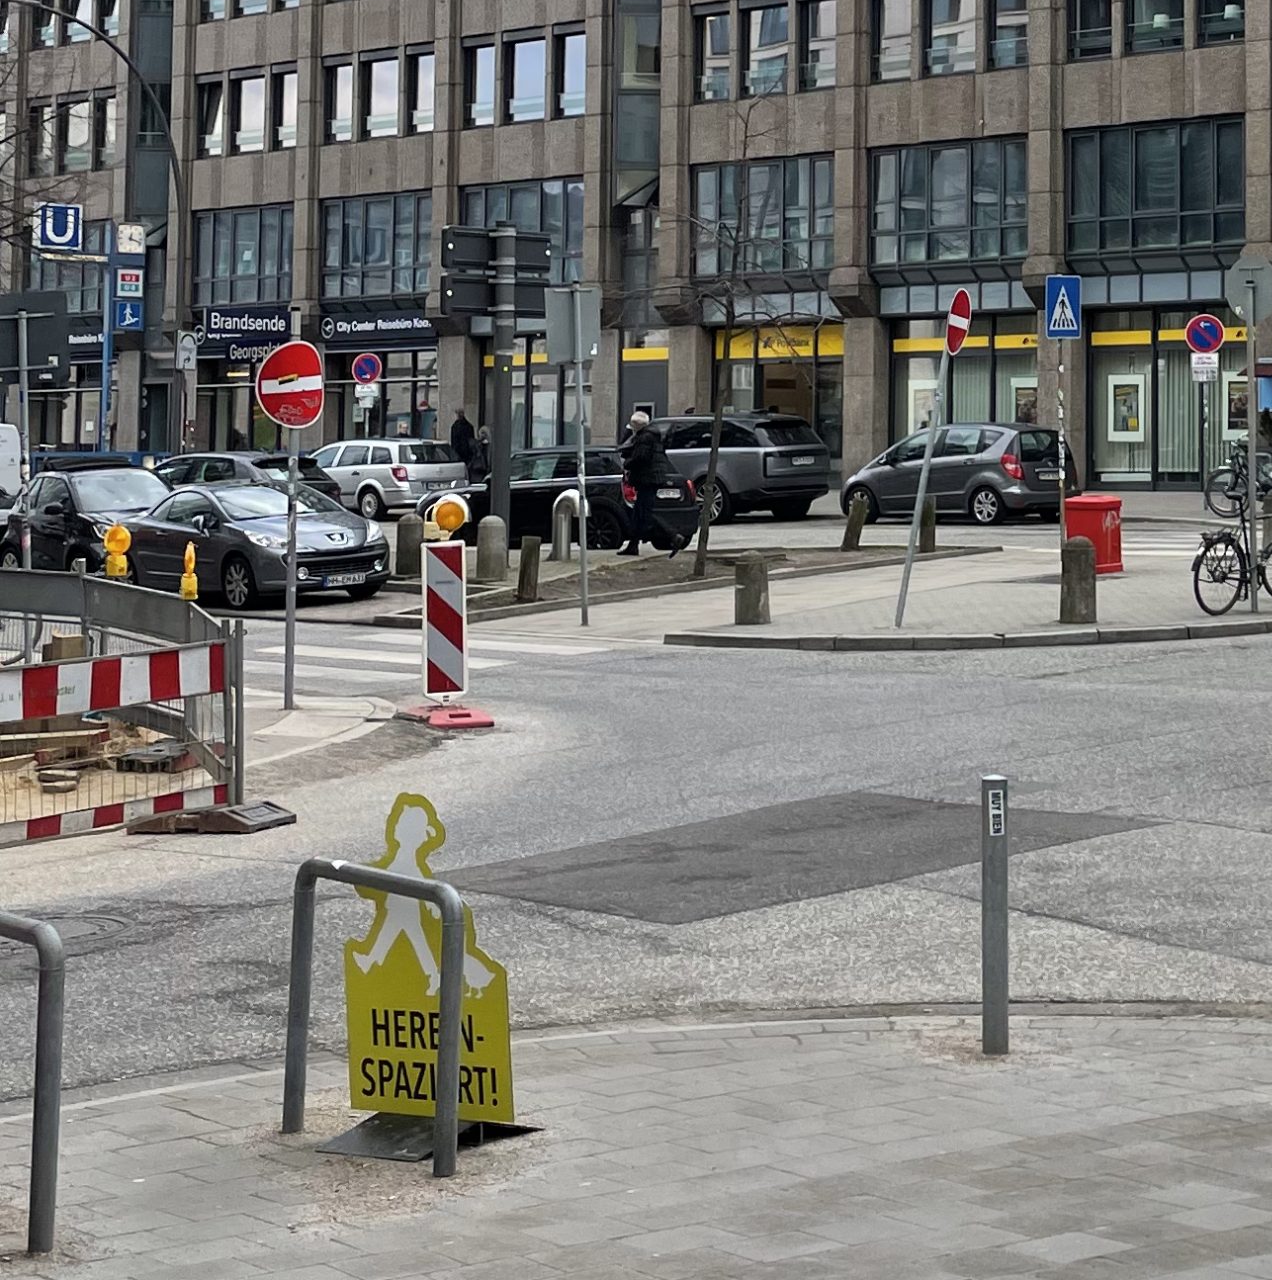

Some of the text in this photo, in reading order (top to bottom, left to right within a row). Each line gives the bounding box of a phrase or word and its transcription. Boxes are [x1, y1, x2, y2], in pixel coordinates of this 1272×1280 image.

[45, 207, 75, 244] U
[210, 312, 286, 331] Brandsende
[229, 341, 284, 362] Georgspla
[991, 792, 1003, 834] MUY BIEN
[371, 1008, 485, 1053] HEREN-
[361, 1057, 498, 1106] SPAZIRT!
